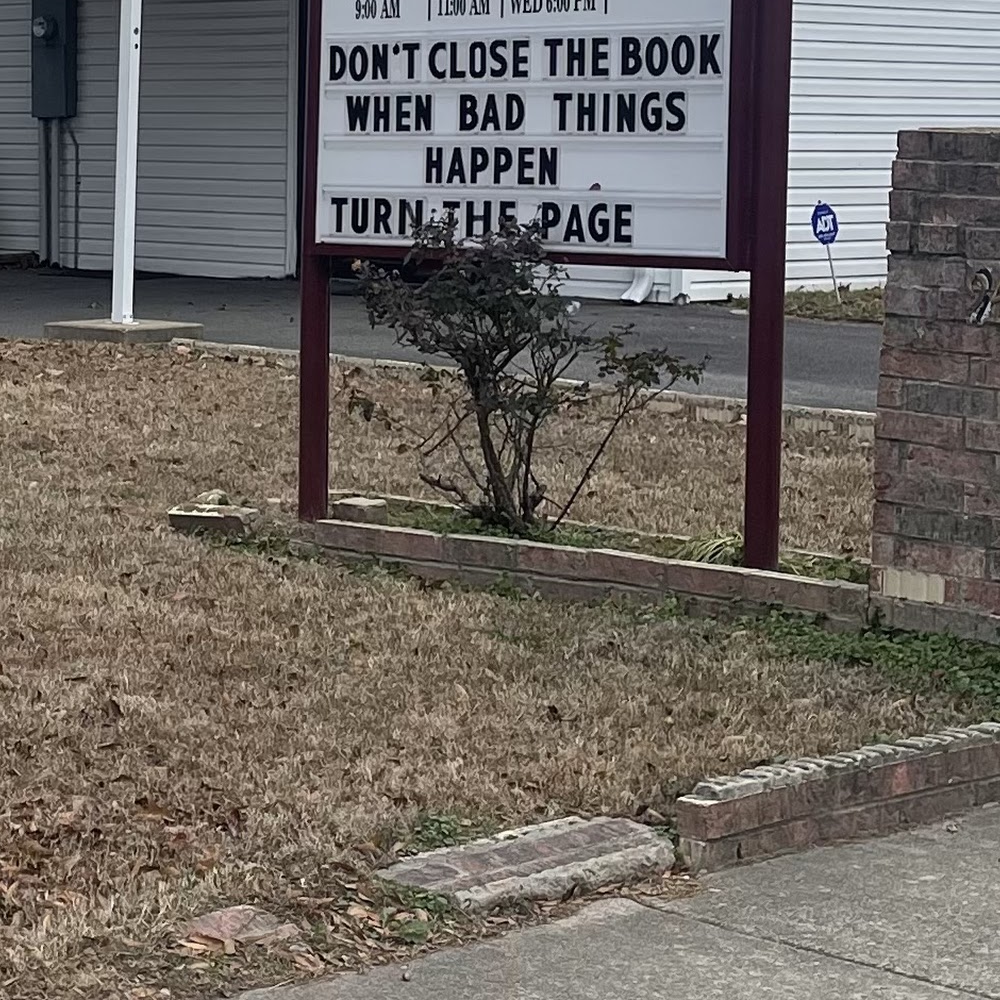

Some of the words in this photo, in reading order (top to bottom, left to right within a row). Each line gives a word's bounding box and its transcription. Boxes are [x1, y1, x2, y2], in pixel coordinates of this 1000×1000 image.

[329, 42, 421, 81] DON'T
[428, 39, 530, 79] CLOSE
[543, 37, 610, 78] THE
[620, 33, 722, 77] BOOK
[346, 93, 433, 133] WHEN
[458, 93, 526, 132] BAD
[553, 90, 687, 133] THINGS
[425, 146, 558, 186] HAPPEN
[330, 197, 424, 235] TURN
[541, 201, 633, 243] PAGE
[816, 215, 834, 233] ADT
